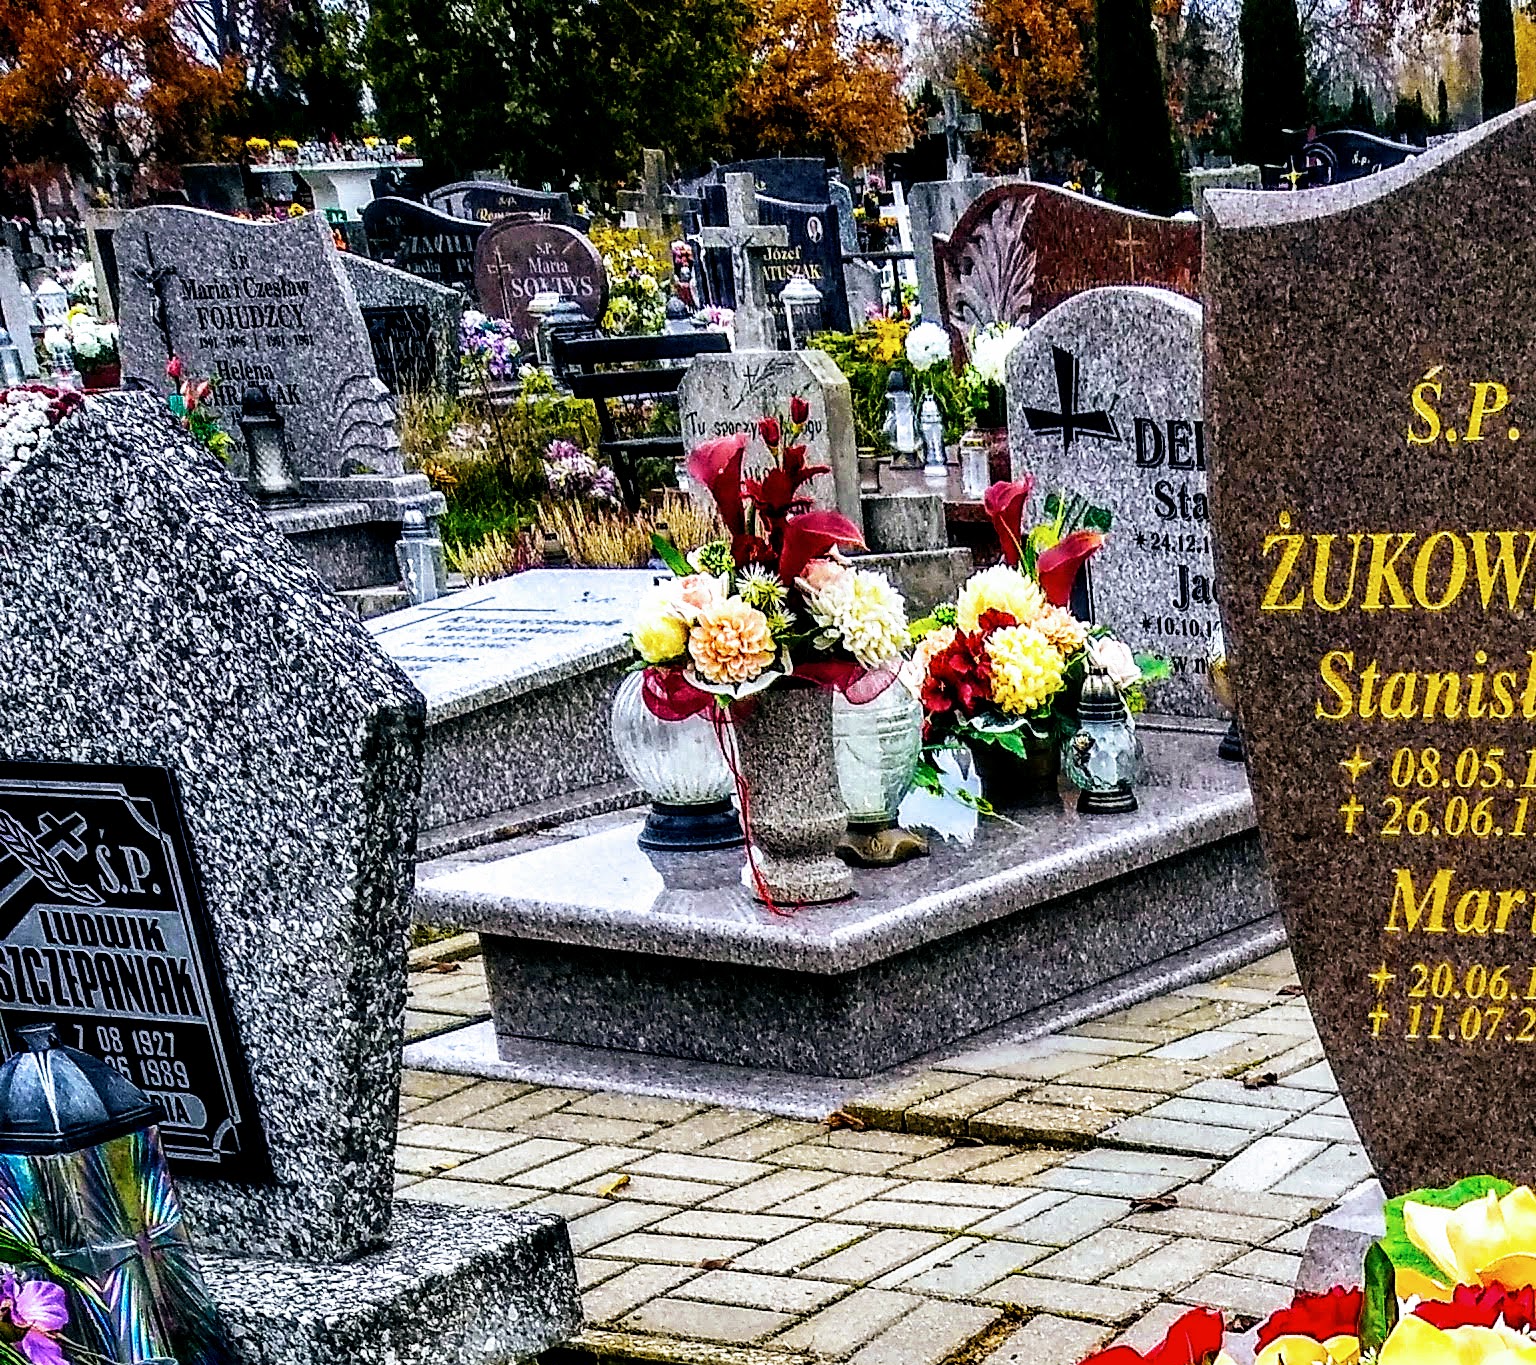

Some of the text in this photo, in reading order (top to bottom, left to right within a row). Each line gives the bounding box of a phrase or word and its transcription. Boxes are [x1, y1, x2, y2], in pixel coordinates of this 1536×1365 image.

[528, 257, 569, 274] Maria
[763, 246, 802, 261] Józef
[179, 278, 231, 300] Maria
[242, 274, 309, 299] Czesław
[195, 303, 306, 331] FOJUDZCY
[216, 359, 275, 381] Helena
[1407, 365, 1521, 444] Ś.P.
[686, 411, 706, 436] Tu
[97, 829, 163, 896] Ś.P.
[38, 910, 168, 952] LUDWIK
[0, 945, 203, 1017] SZCZEPANIAK
[97, 1026, 124, 1053] 08
[131, 1030, 175, 1058] 1927
[139, 1058, 190, 1089] 1989
